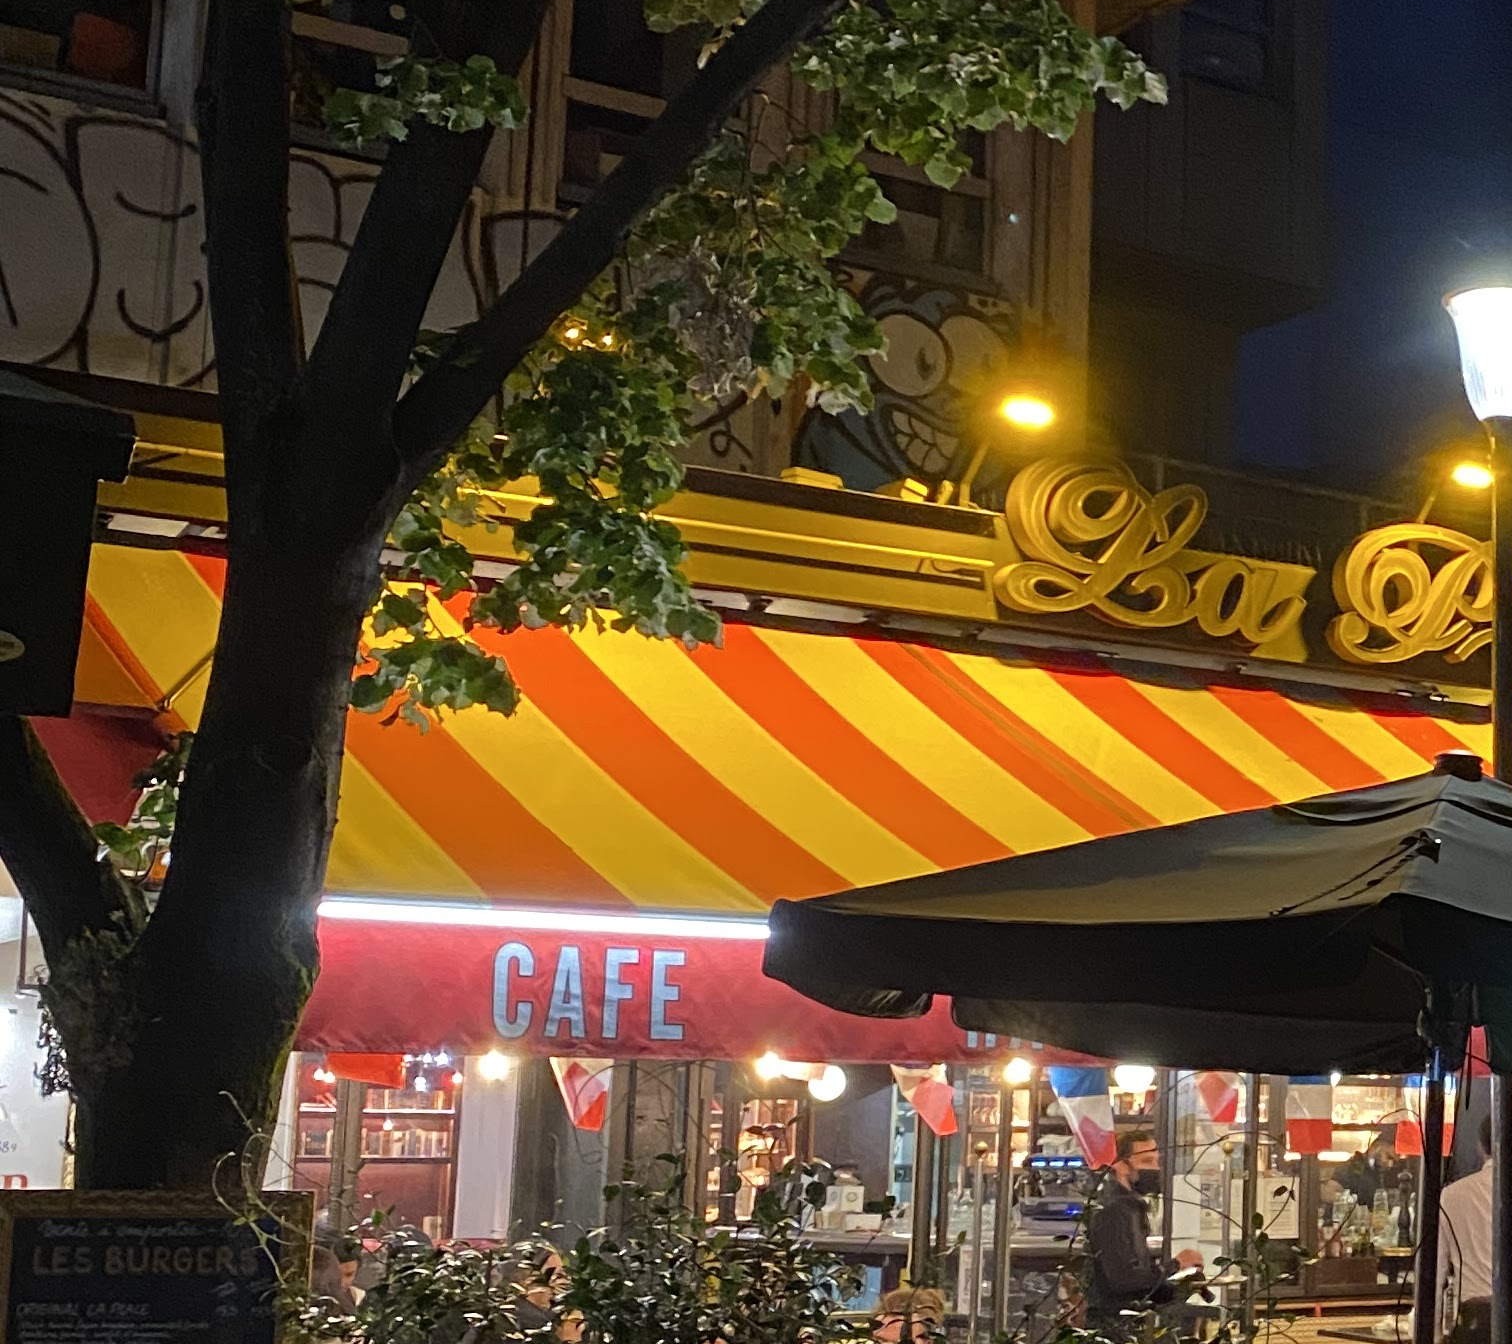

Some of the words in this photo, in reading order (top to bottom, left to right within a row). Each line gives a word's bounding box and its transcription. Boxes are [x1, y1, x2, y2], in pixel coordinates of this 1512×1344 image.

[994, 456, 1307, 639] La
[491, 940, 687, 1042] CAFE
[33, 1245, 93, 1275] LES
[104, 1244, 259, 1276] BURGERS
